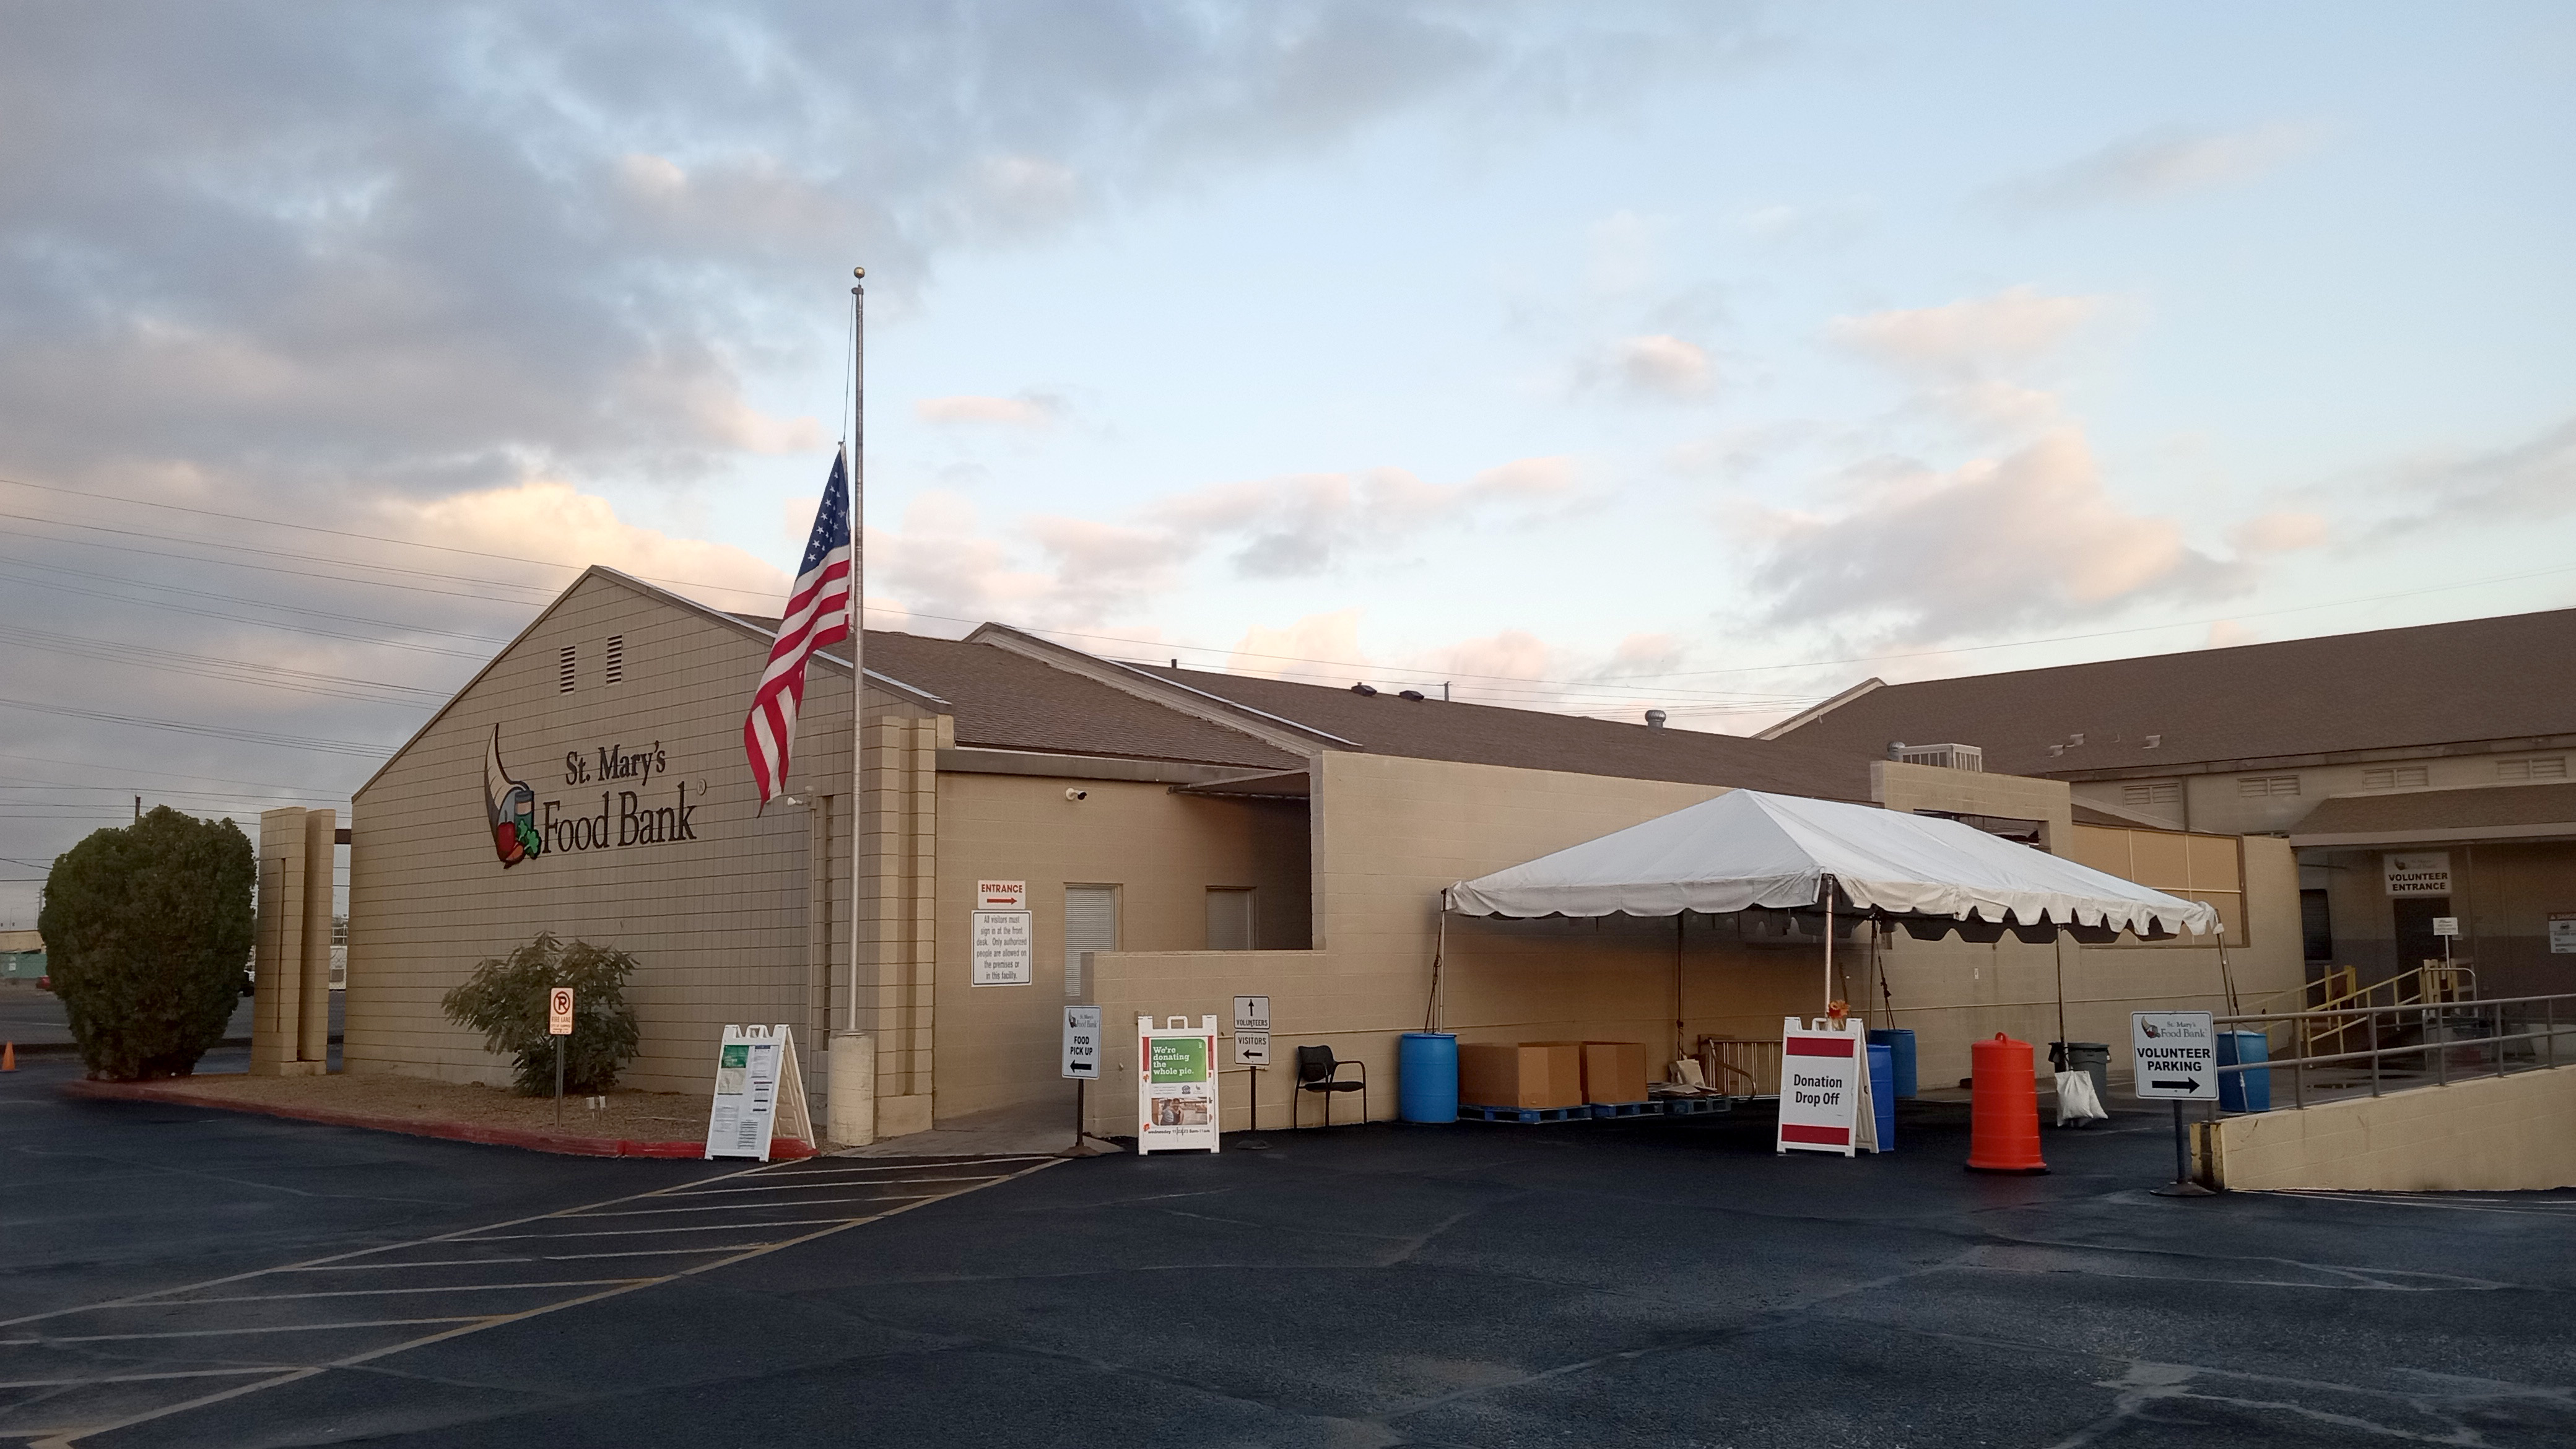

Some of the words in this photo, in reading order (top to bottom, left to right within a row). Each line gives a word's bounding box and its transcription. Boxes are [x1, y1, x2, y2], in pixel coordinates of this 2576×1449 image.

[565, 751, 591, 785] St.
[598, 739, 666, 786] Mary's
[542, 790, 610, 853] Food
[617, 780, 697, 846] Bank
[2388, 872, 2448, 881] VOLUNTEER
[981, 884, 1023, 893] ENTRANCE
[2392, 882, 2446, 891] ENTRANCE
[991, 915, 1007, 923] visitors
[980, 926, 990, 936] sign
[991, 926, 996, 934] in
[1012, 926, 1023, 934] front
[992, 938, 1002, 947] Only
[1004, 938, 1027, 946] authorized
[977, 949, 992, 958] people
[1003, 949, 1019, 957] allowed
[993, 960, 1013, 970] premises
[986, 972, 991, 980] in
[991, 971, 1000, 980] this
[2160, 1027, 2182, 1038] Food
[2183, 1028, 2206, 1038] Bank
[1074, 1036, 1089, 1045] FOOD
[1238, 1037, 1266, 1045] VISITORS
[1070, 1046, 1084, 1056] PICK
[1085, 1047, 1093, 1056] UP
[2137, 1047, 2211, 1058] VOLUNTEER
[1153, 1053, 1190, 1061] donating
[2147, 1061, 2202, 1072] PARKING
[1178, 1068, 1194, 1076] pie.
[1793, 1074, 1842, 1088] Donation
[1795, 1091, 1821, 1107] Drop
[1822, 1092, 1840, 1105] Off
